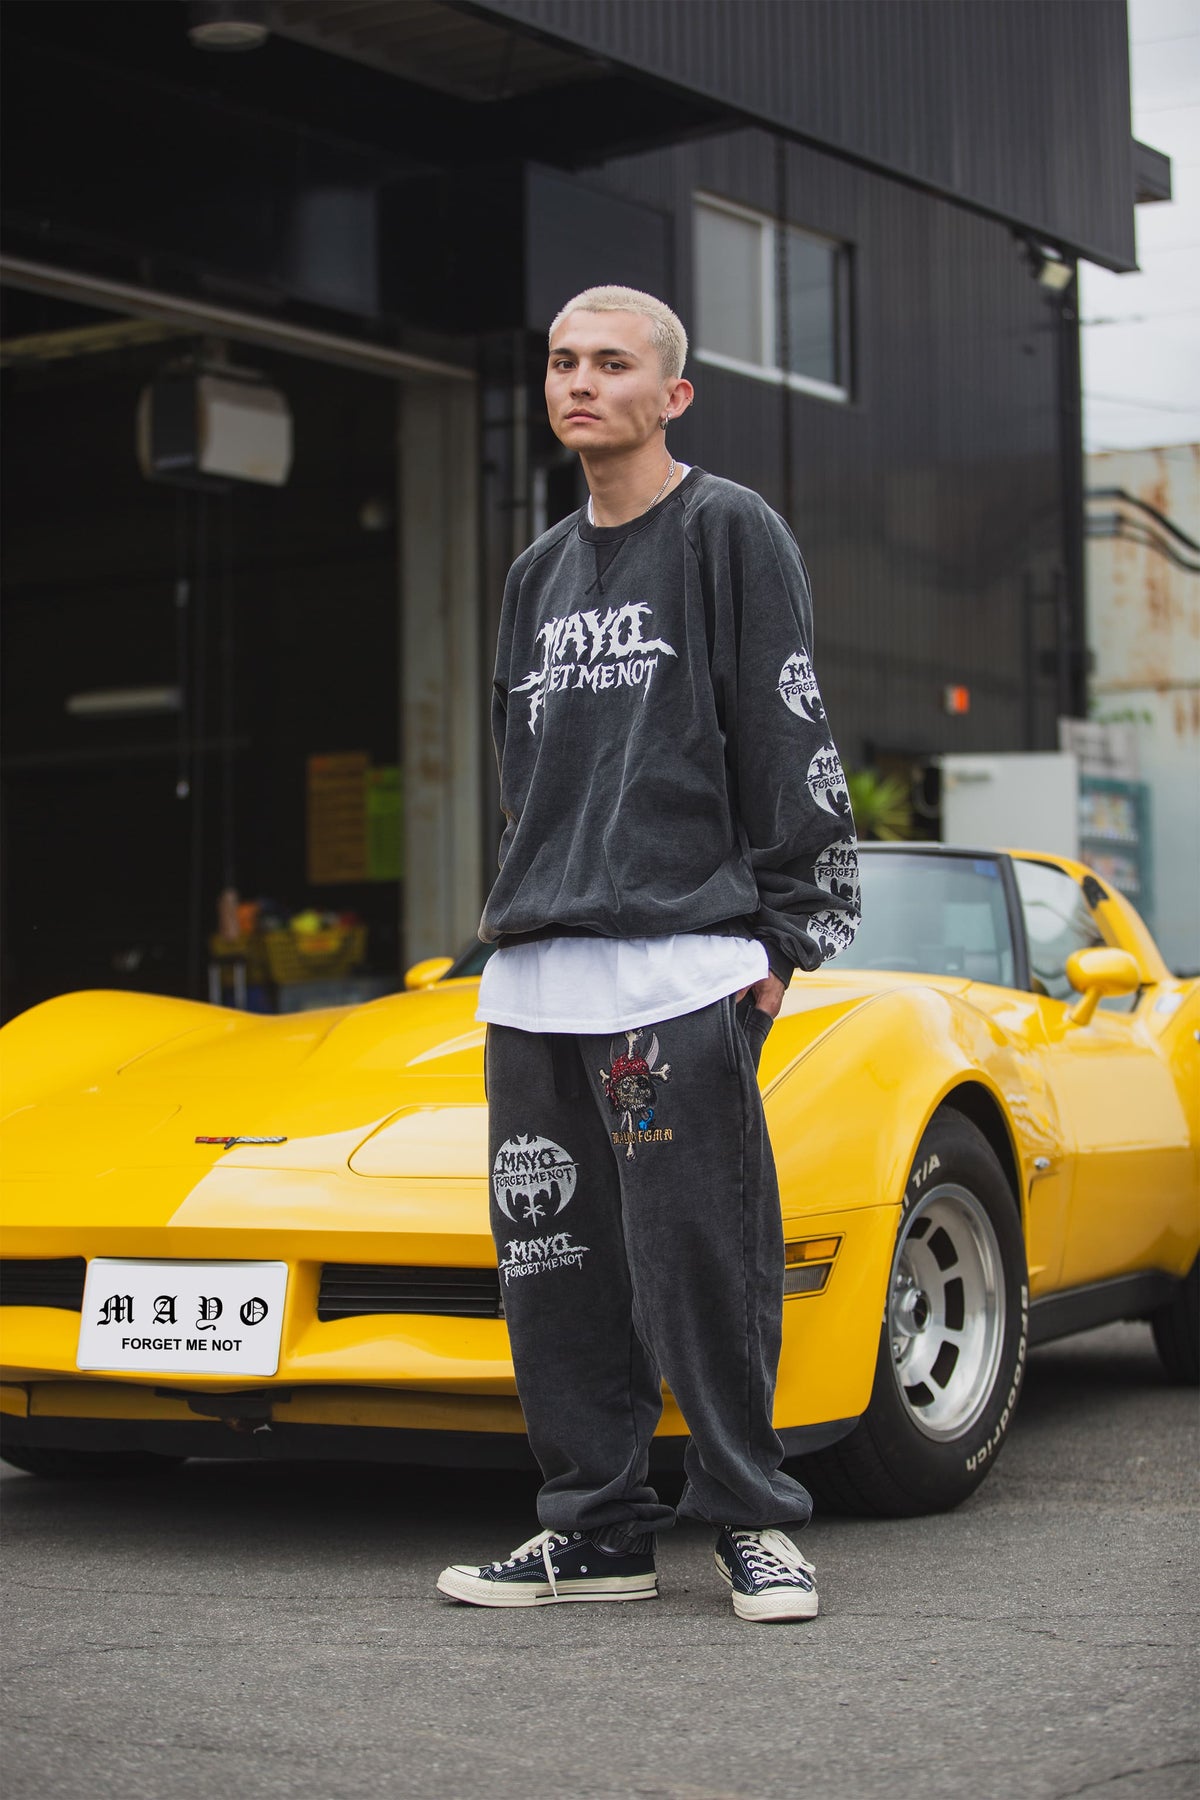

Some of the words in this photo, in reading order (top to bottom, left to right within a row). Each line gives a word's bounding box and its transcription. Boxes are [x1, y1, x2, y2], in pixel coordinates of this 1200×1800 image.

[615, 655, 658, 702] NOT
[817, 867, 855, 882] FORGET
[493, 1147, 576, 1175] MAYO
[912, 1153, 941, 1189] T/A
[495, 1174, 527, 1194] FORGET
[547, 1168, 571, 1184] NOT
[498, 1232, 590, 1268] MAYO
[504, 1262, 540, 1287] FORGET
[559, 1252, 583, 1271] NOT
[122, 1338, 182, 1350] FORGET
[186, 1339, 207, 1351] ME
[212, 1340, 242, 1351] NOT
